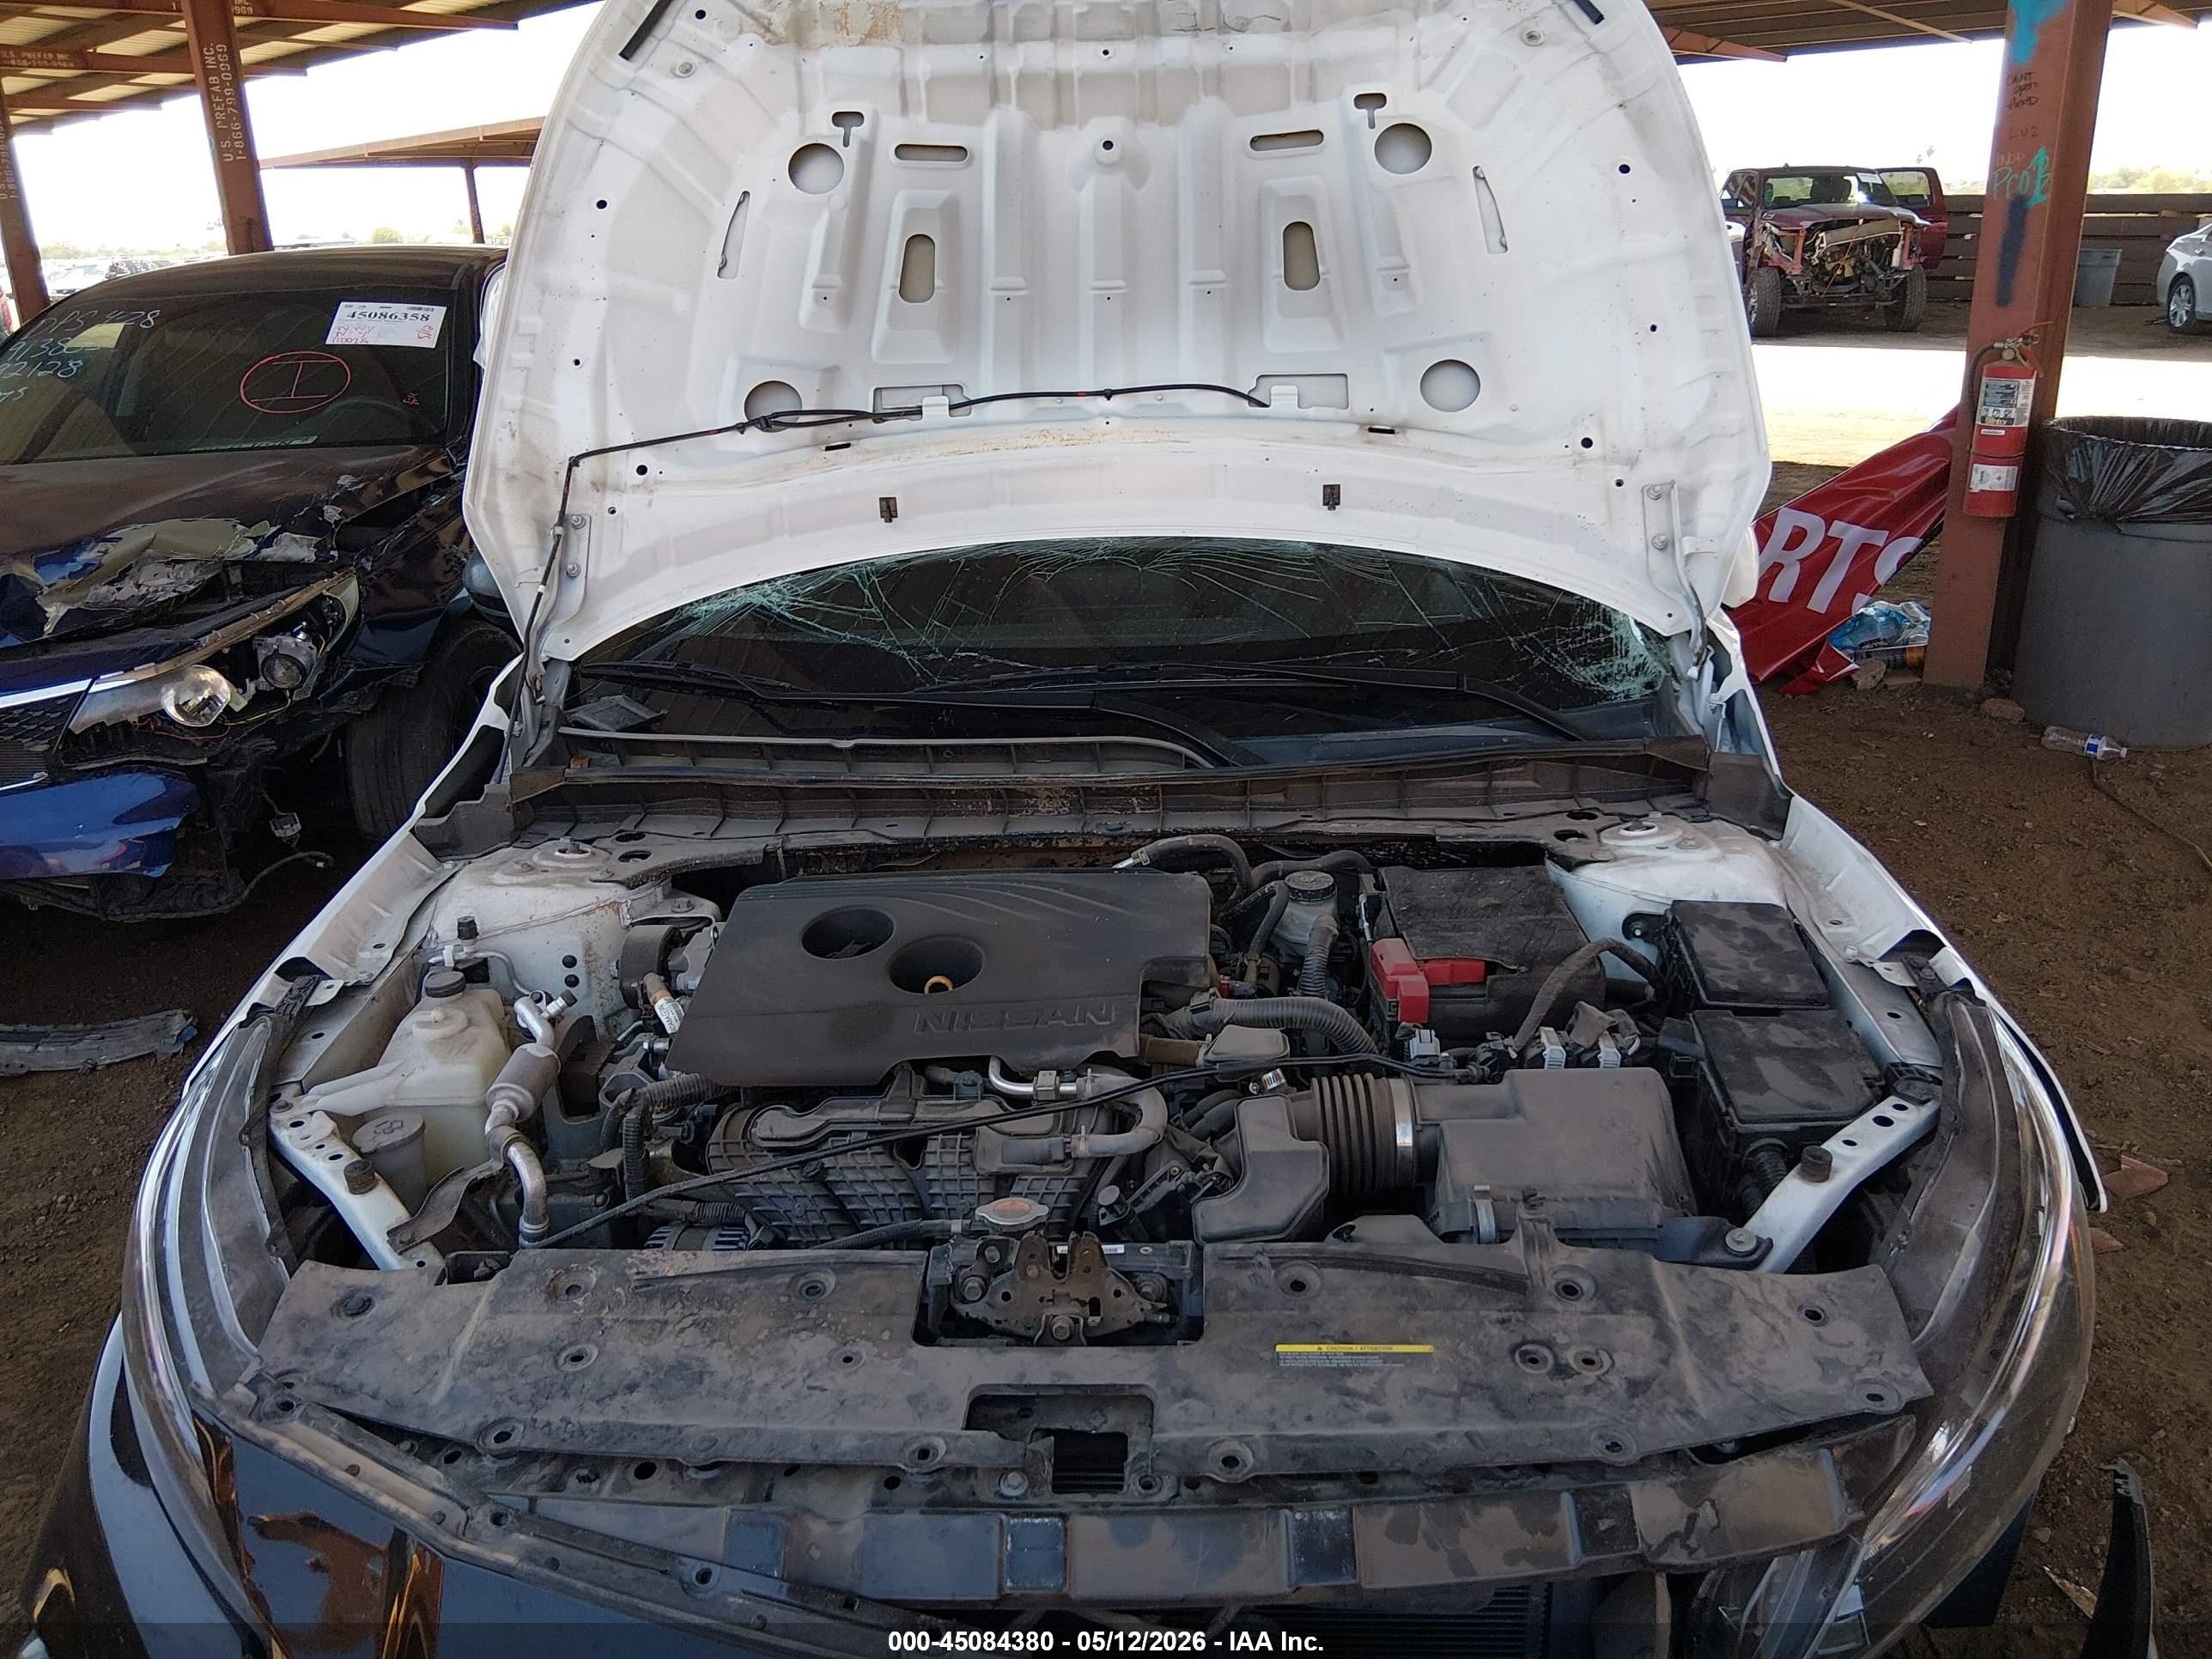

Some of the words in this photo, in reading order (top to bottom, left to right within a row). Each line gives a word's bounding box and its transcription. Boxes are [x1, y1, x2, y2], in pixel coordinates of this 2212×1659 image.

[204, 43, 217, 69] INC.
[209, 76, 228, 128] PREFAB
[216, 44, 246, 160] 1-866-799-0969
[346, 311, 430, 321] 45086358
[914, 1003, 1115, 1033] NISSAN
